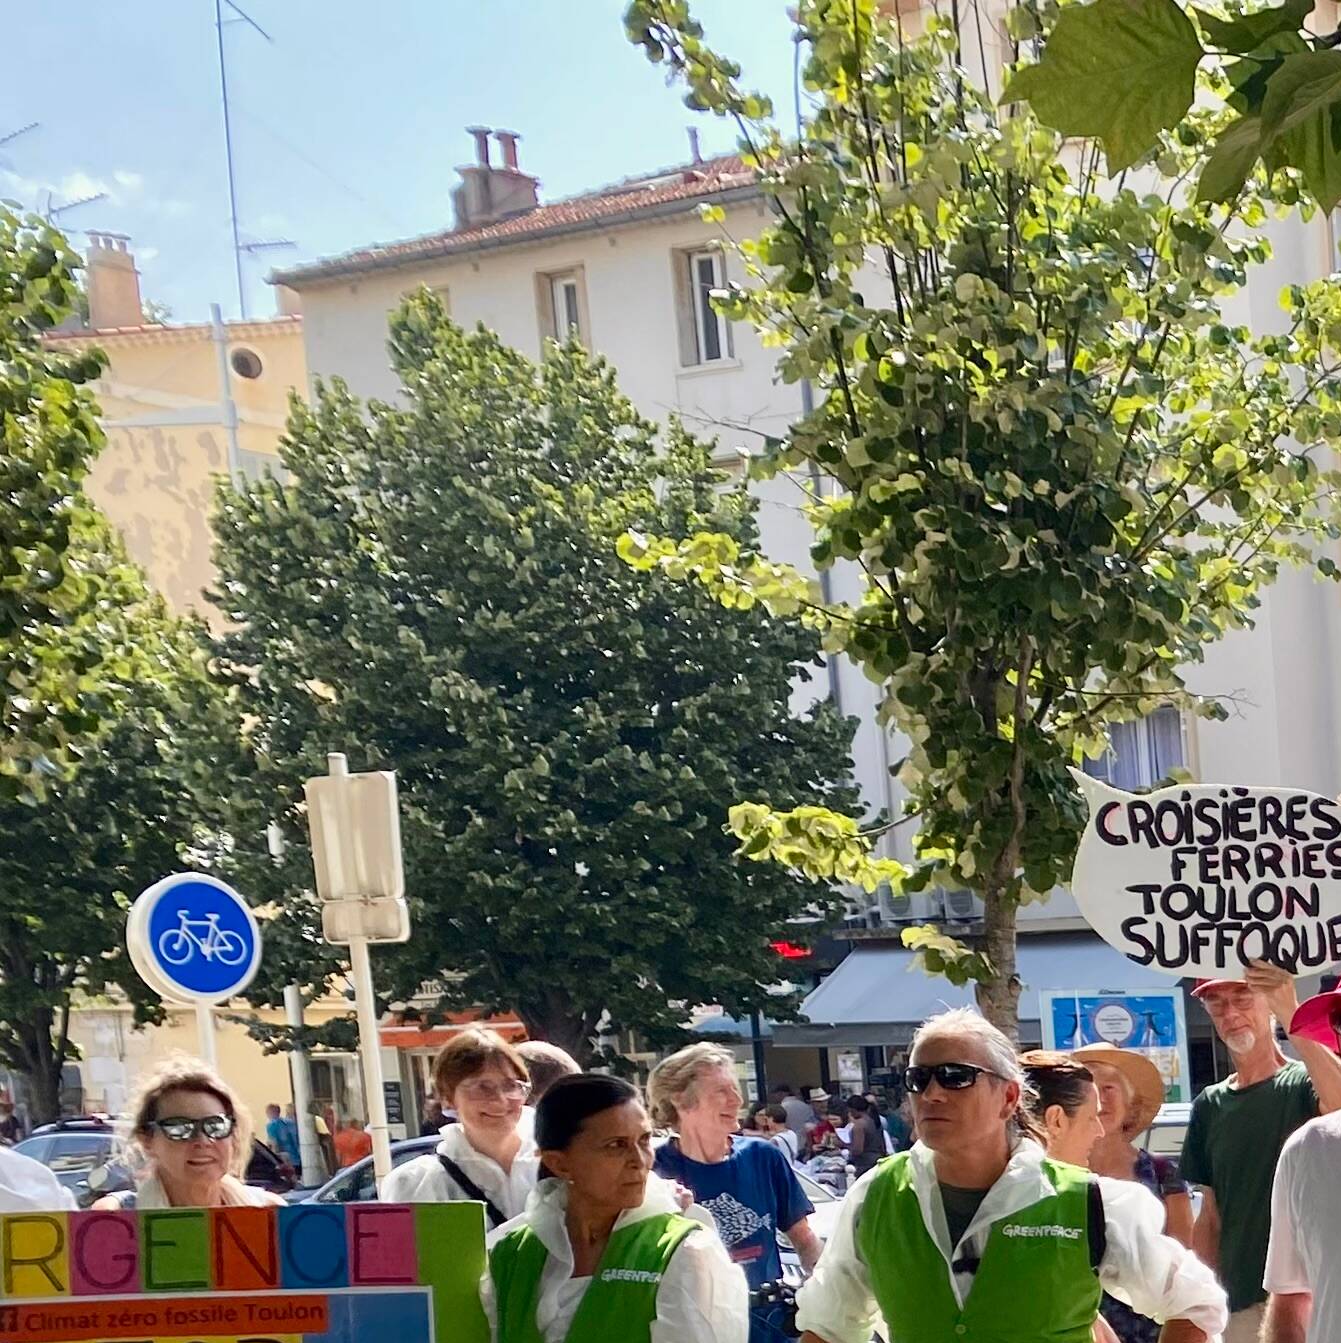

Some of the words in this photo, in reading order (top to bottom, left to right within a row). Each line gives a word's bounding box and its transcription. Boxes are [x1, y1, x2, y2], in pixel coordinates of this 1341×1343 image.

[1125, 882, 1320, 922] TOULON
[1002, 1224, 1083, 1239] GREENPEACE
[24, 1308, 99, 1332] Climat
[107, 1309, 157, 1329] zéro
[165, 1304, 238, 1325] fossile
[247, 1302, 325, 1322] Toulon
